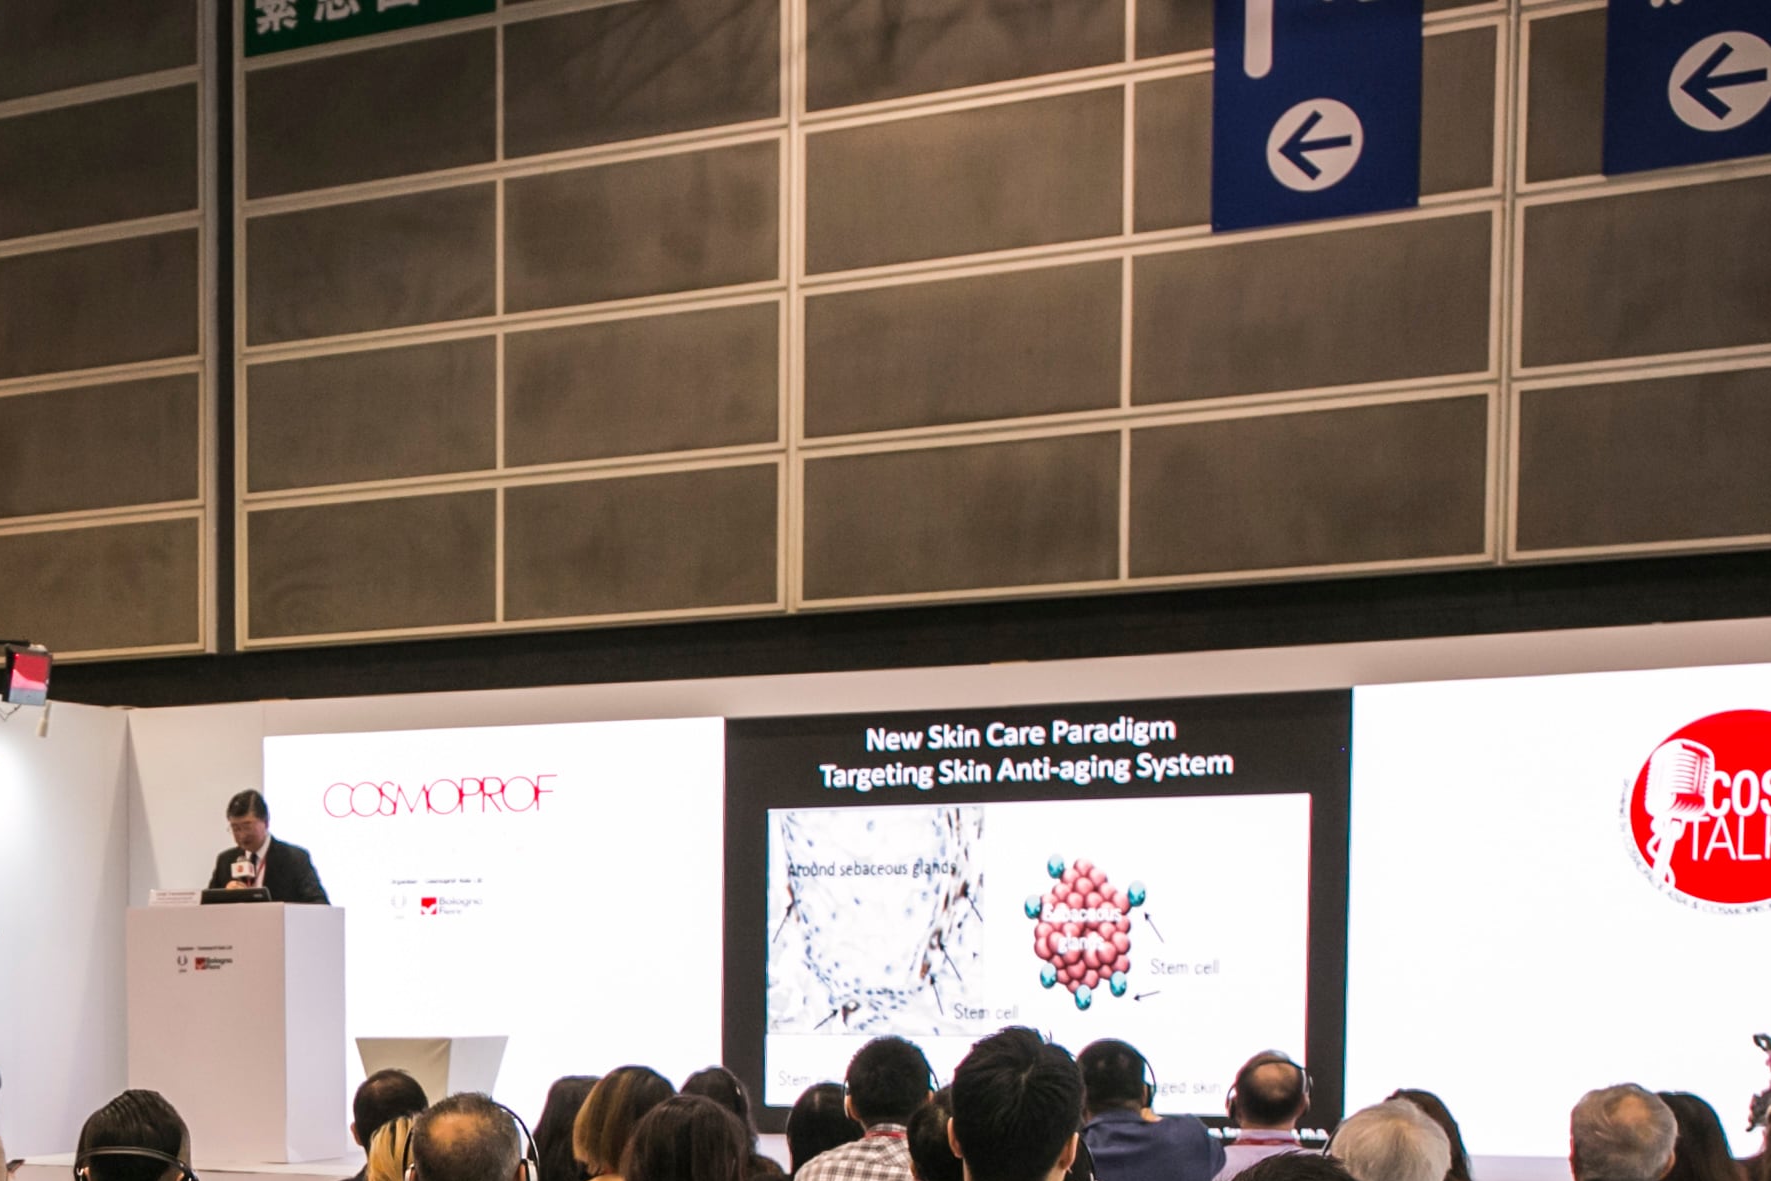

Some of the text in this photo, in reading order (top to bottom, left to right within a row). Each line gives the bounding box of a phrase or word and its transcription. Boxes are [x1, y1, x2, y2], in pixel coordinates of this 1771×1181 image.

[865, 716, 1176, 752] New Skin Care Paradigm
[819, 752, 1235, 791] Targeting Skin Anti-aging System
[323, 774, 558, 818] COSMOPROF
[788, 861, 835, 878] Around
[839, 860, 909, 878] sebaceous
[1151, 958, 1221, 975] Stem cell
[954, 1002, 990, 1020] Stem
